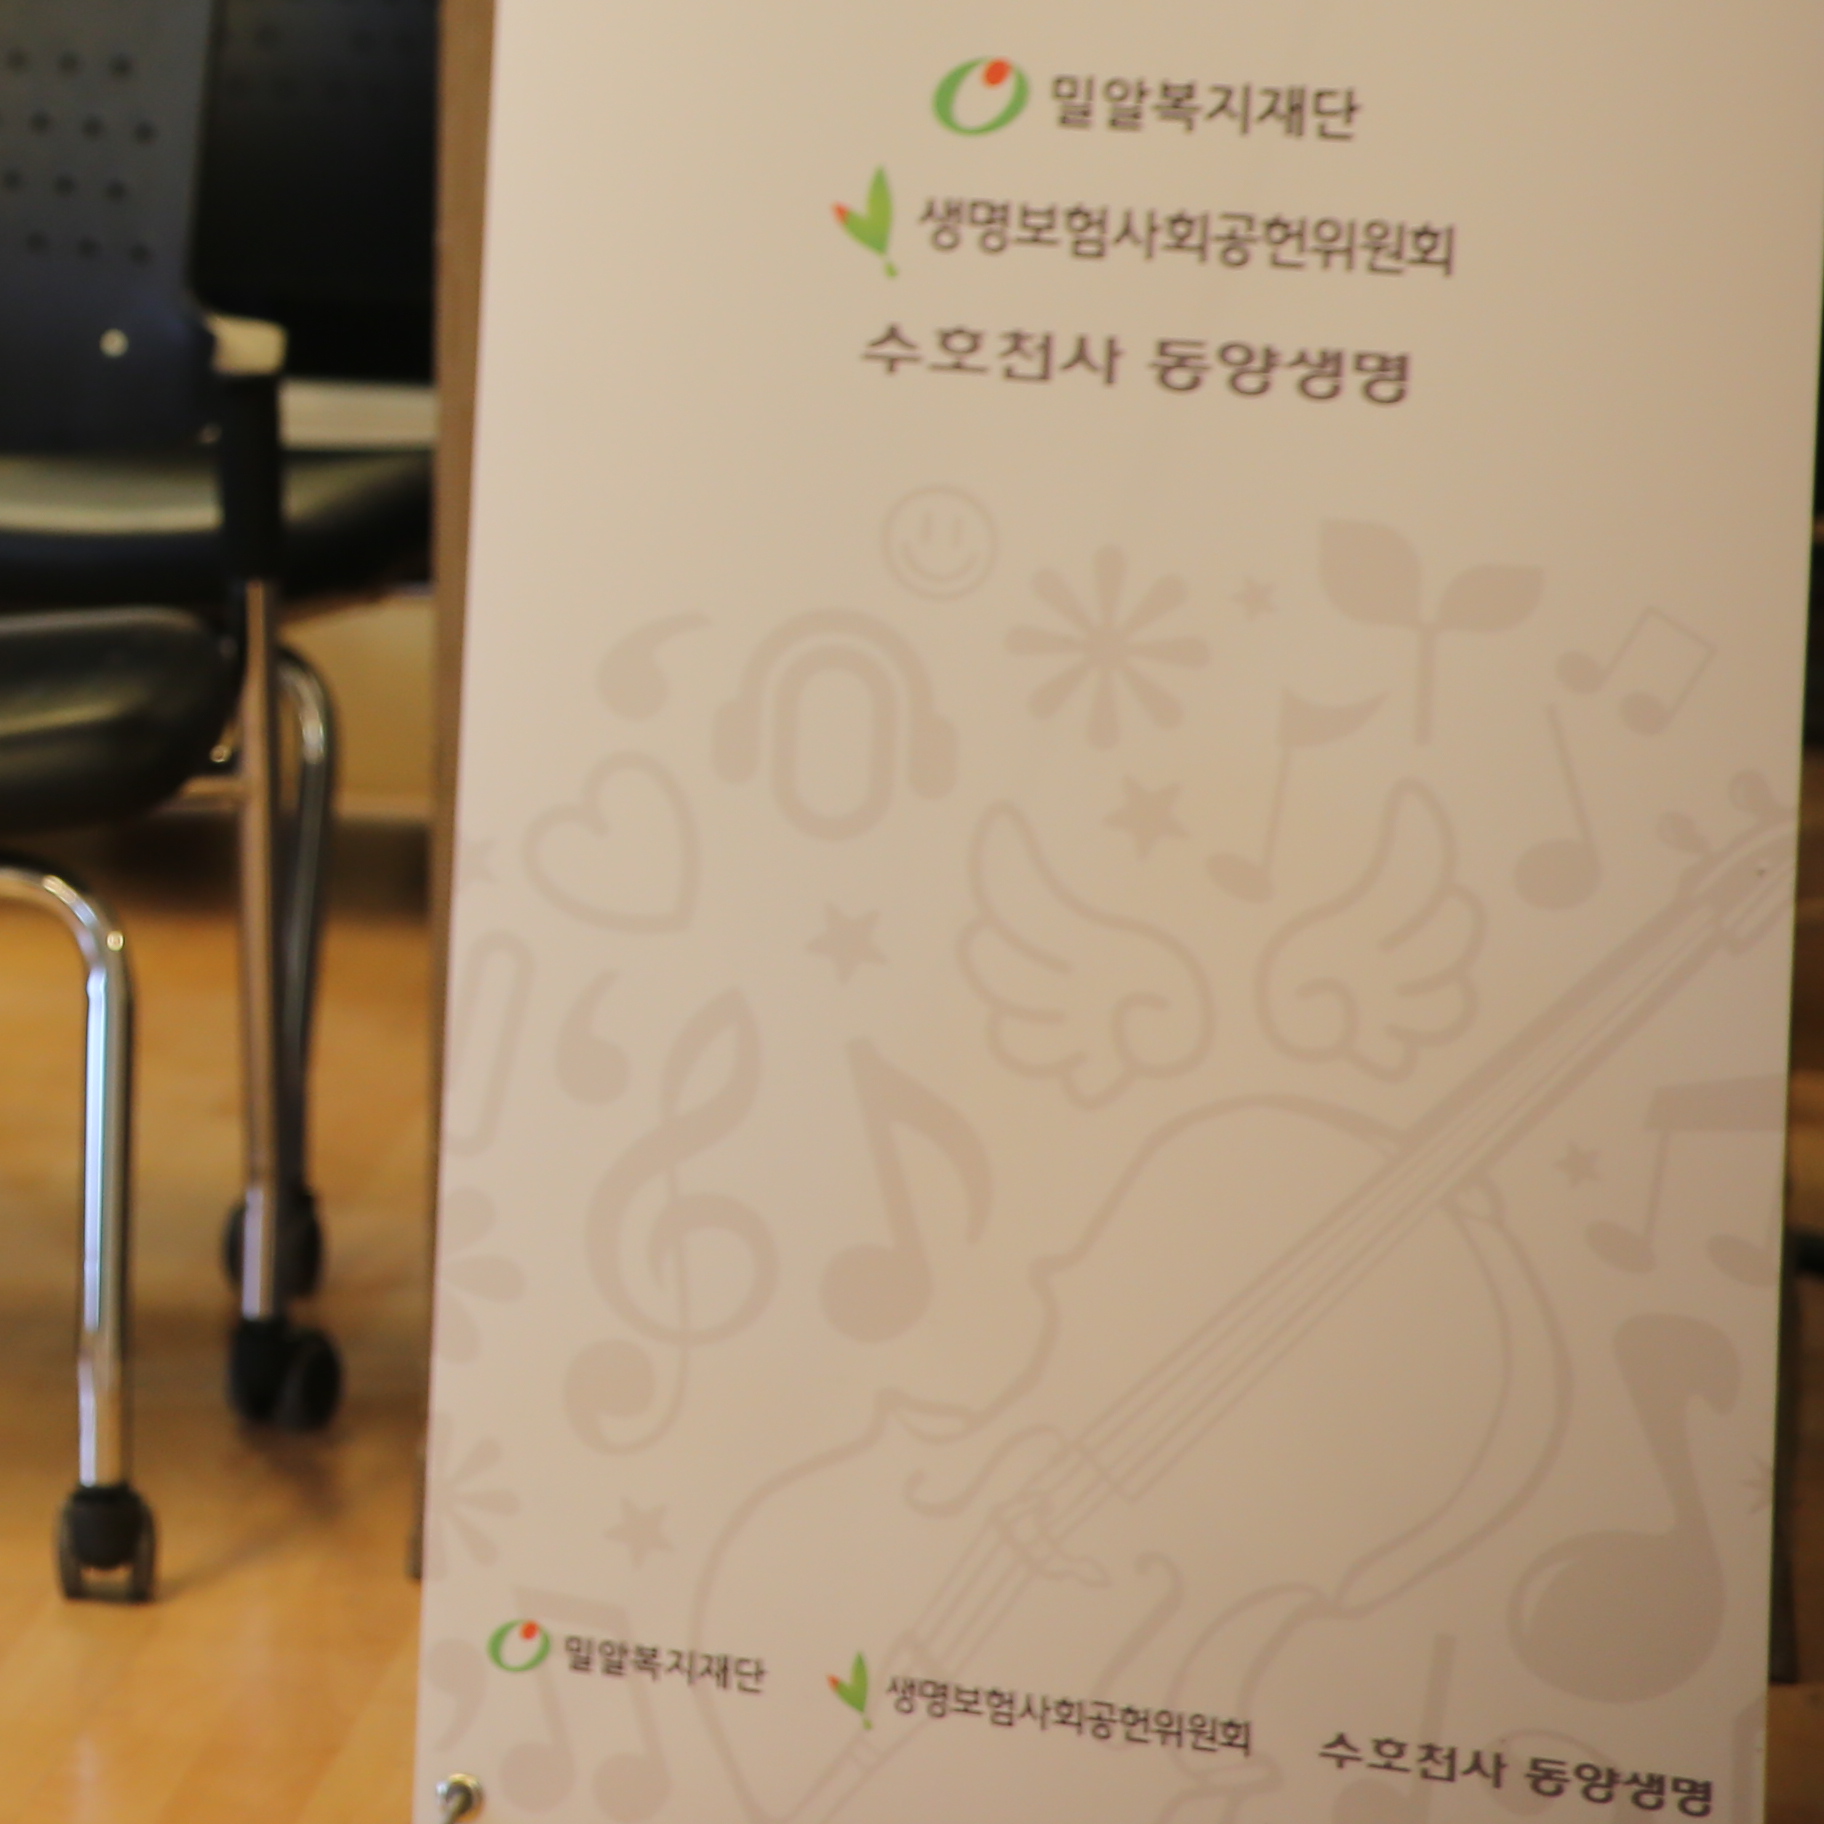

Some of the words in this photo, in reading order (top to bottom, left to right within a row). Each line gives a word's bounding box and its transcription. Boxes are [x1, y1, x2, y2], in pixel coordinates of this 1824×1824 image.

[1050, 73, 1362, 143] 밀알복지재단
[917, 197, 1457, 279] 생명보험사회공헌위원회
[861, 322, 1124, 388] 수호천사
[1148, 337, 1412, 407] 동양생명
[563, 1634, 767, 1695] 밀알복지재단
[885, 1674, 1253, 1758] 생명보험사회공헌위원회
[1317, 1731, 1509, 1790] 수호천사
[1523, 1755, 1714, 1818] 동양생명
